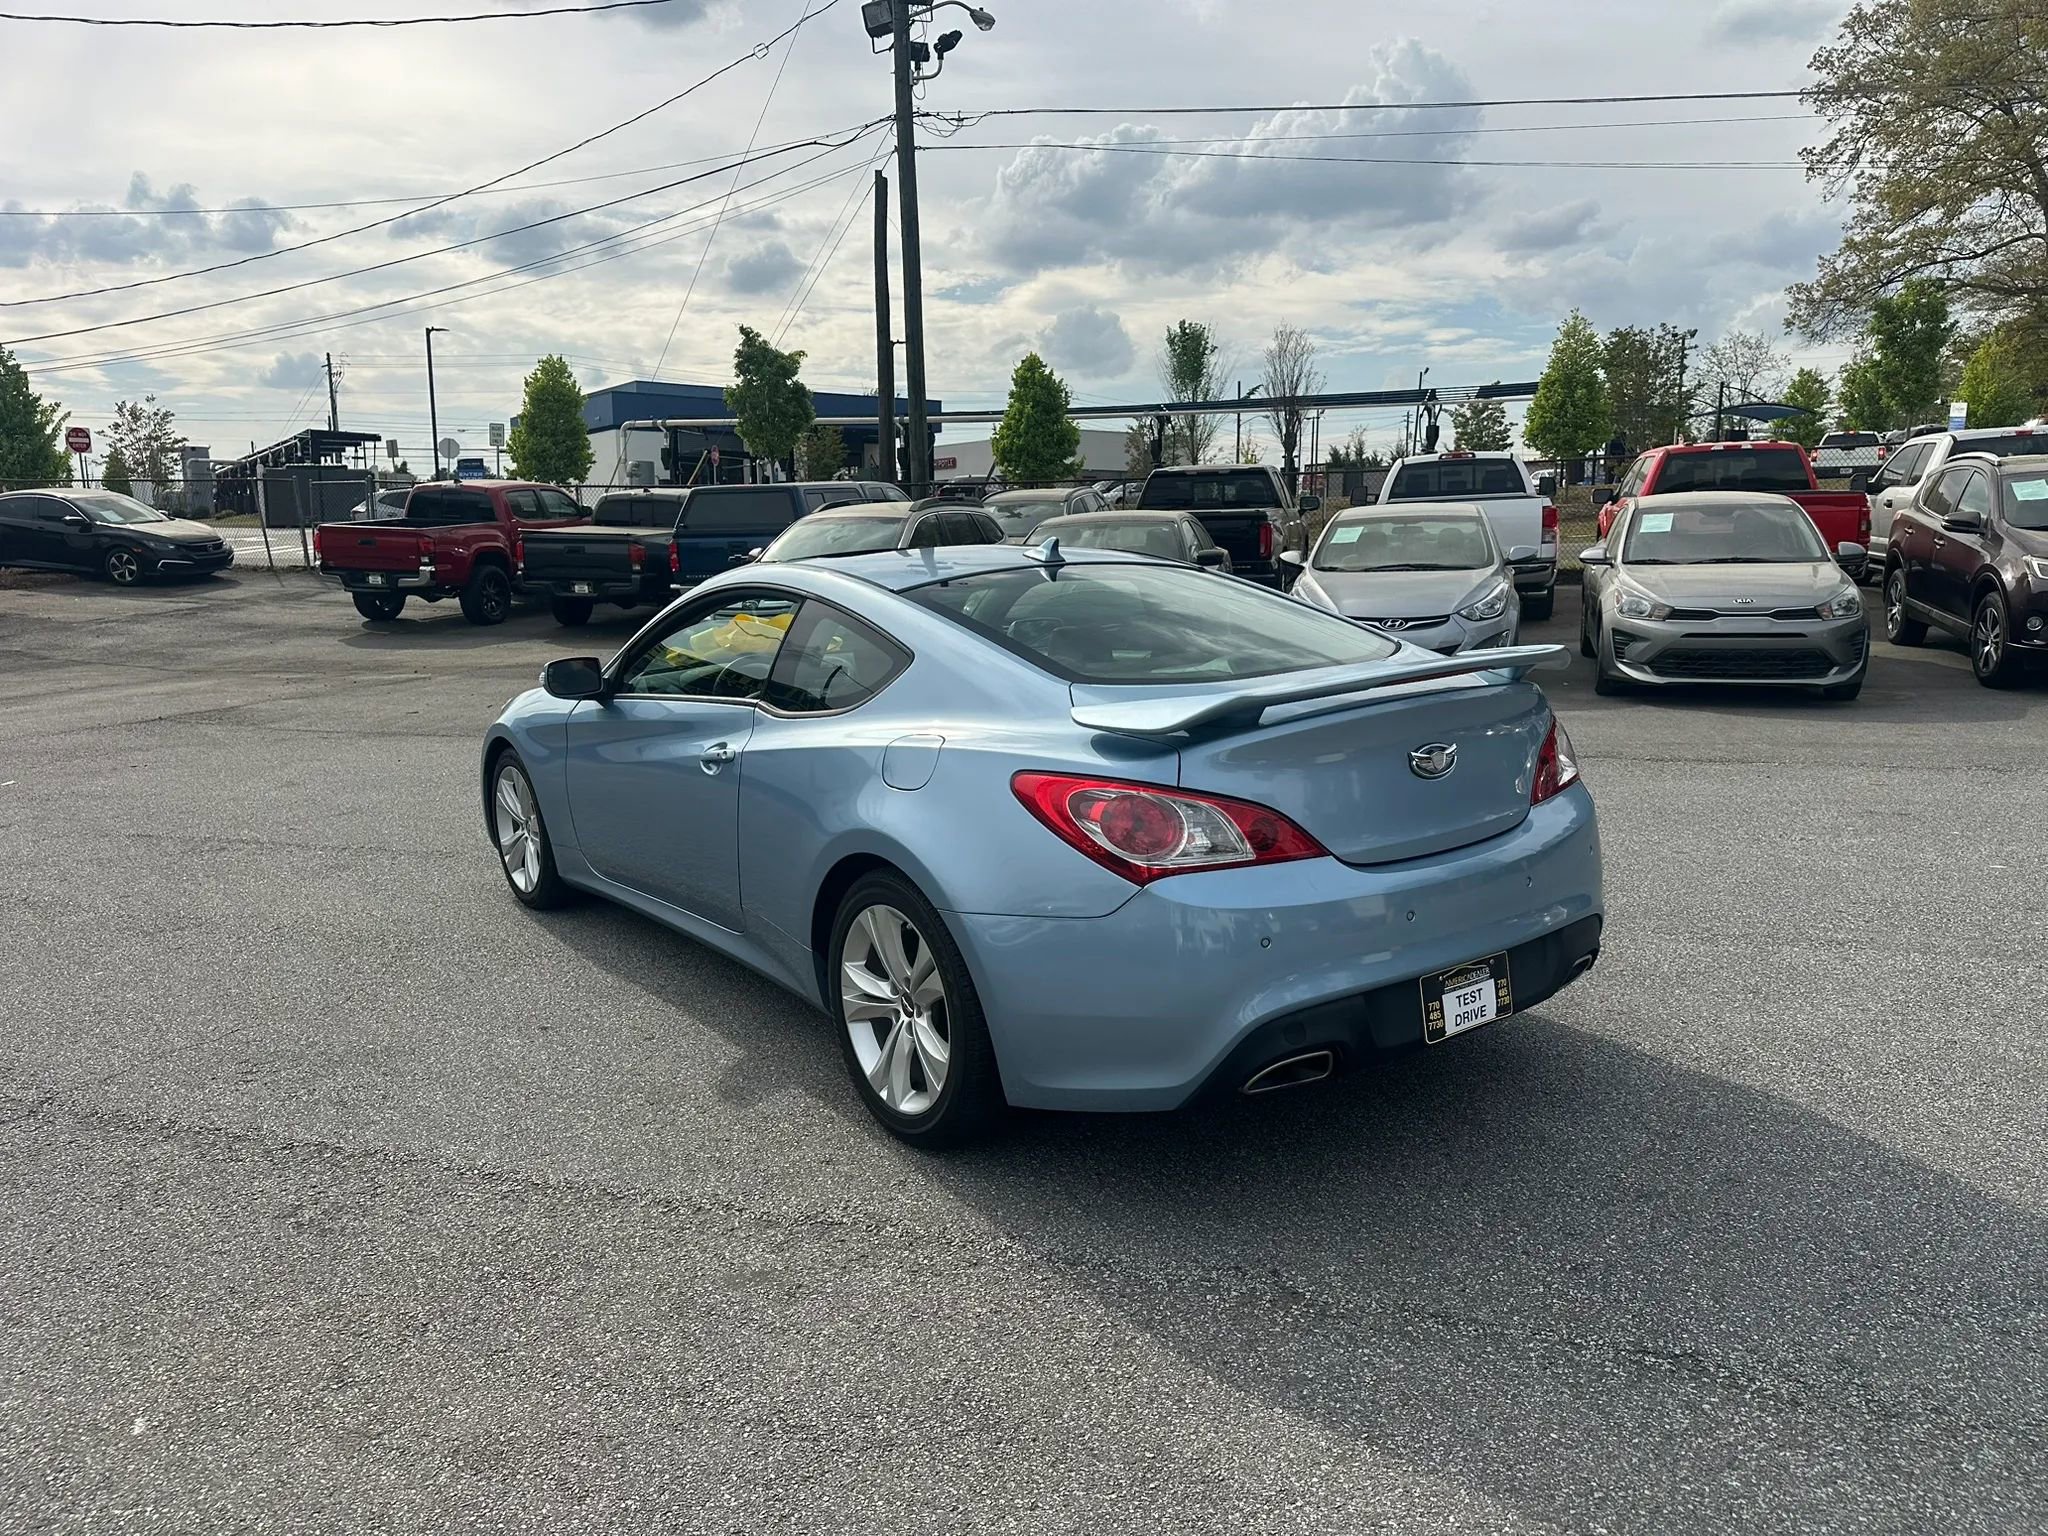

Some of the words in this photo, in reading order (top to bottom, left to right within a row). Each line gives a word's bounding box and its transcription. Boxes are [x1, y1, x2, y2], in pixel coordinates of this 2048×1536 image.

[1456, 988, 1483, 1008] TEST
[1428, 1001, 1440, 1012] 770
[1429, 1010, 1442, 1021] 485
[1455, 1005, 1487, 1027] DRIVE
[1428, 1020, 1444, 1031] 7730
